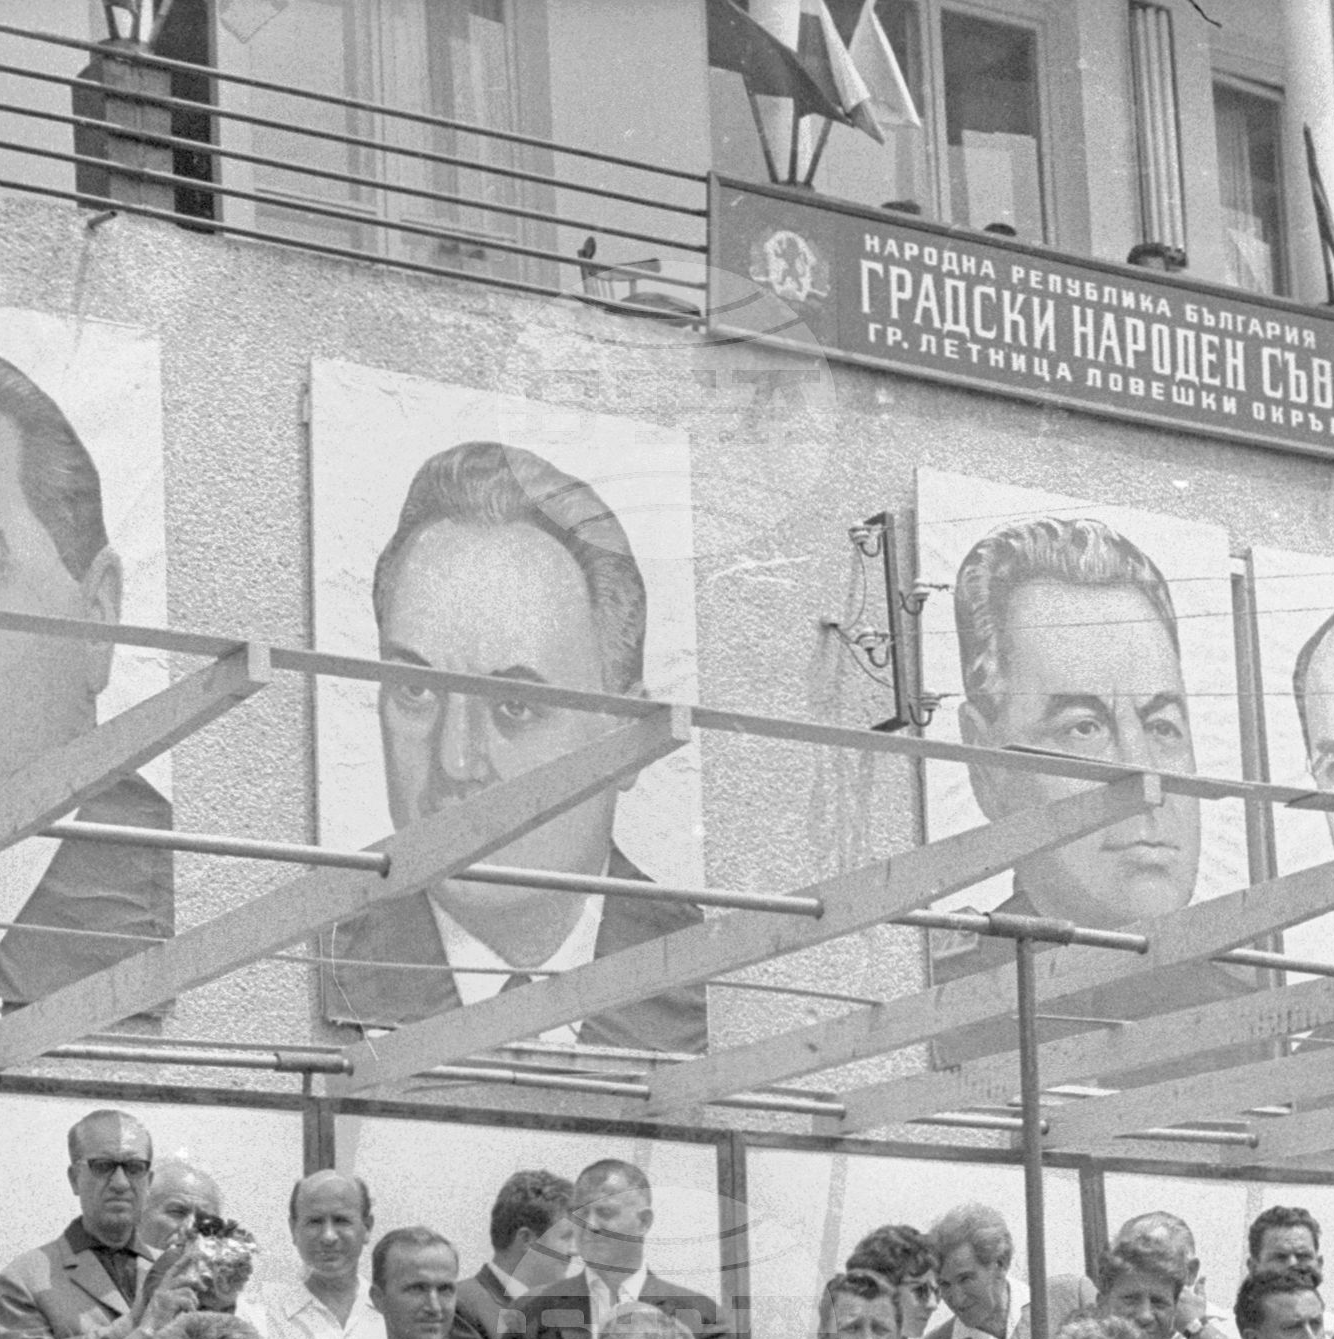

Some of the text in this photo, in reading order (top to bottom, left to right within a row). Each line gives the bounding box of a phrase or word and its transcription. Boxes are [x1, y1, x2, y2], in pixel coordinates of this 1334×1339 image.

[860, 258, 1057, 353] ГРАДСКИ
[1072, 303, 1247, 392] НАРОДЕН
[864, 233, 1316, 350] НАРОДНА РЕПУБЛИКА БЪЛГАРИЯ
[868, 322, 909, 350] ГР.
[919, 333, 1073, 383] ЛЕТНИЦА
[1085, 366, 1237, 415] ЛОВЕШКИ
